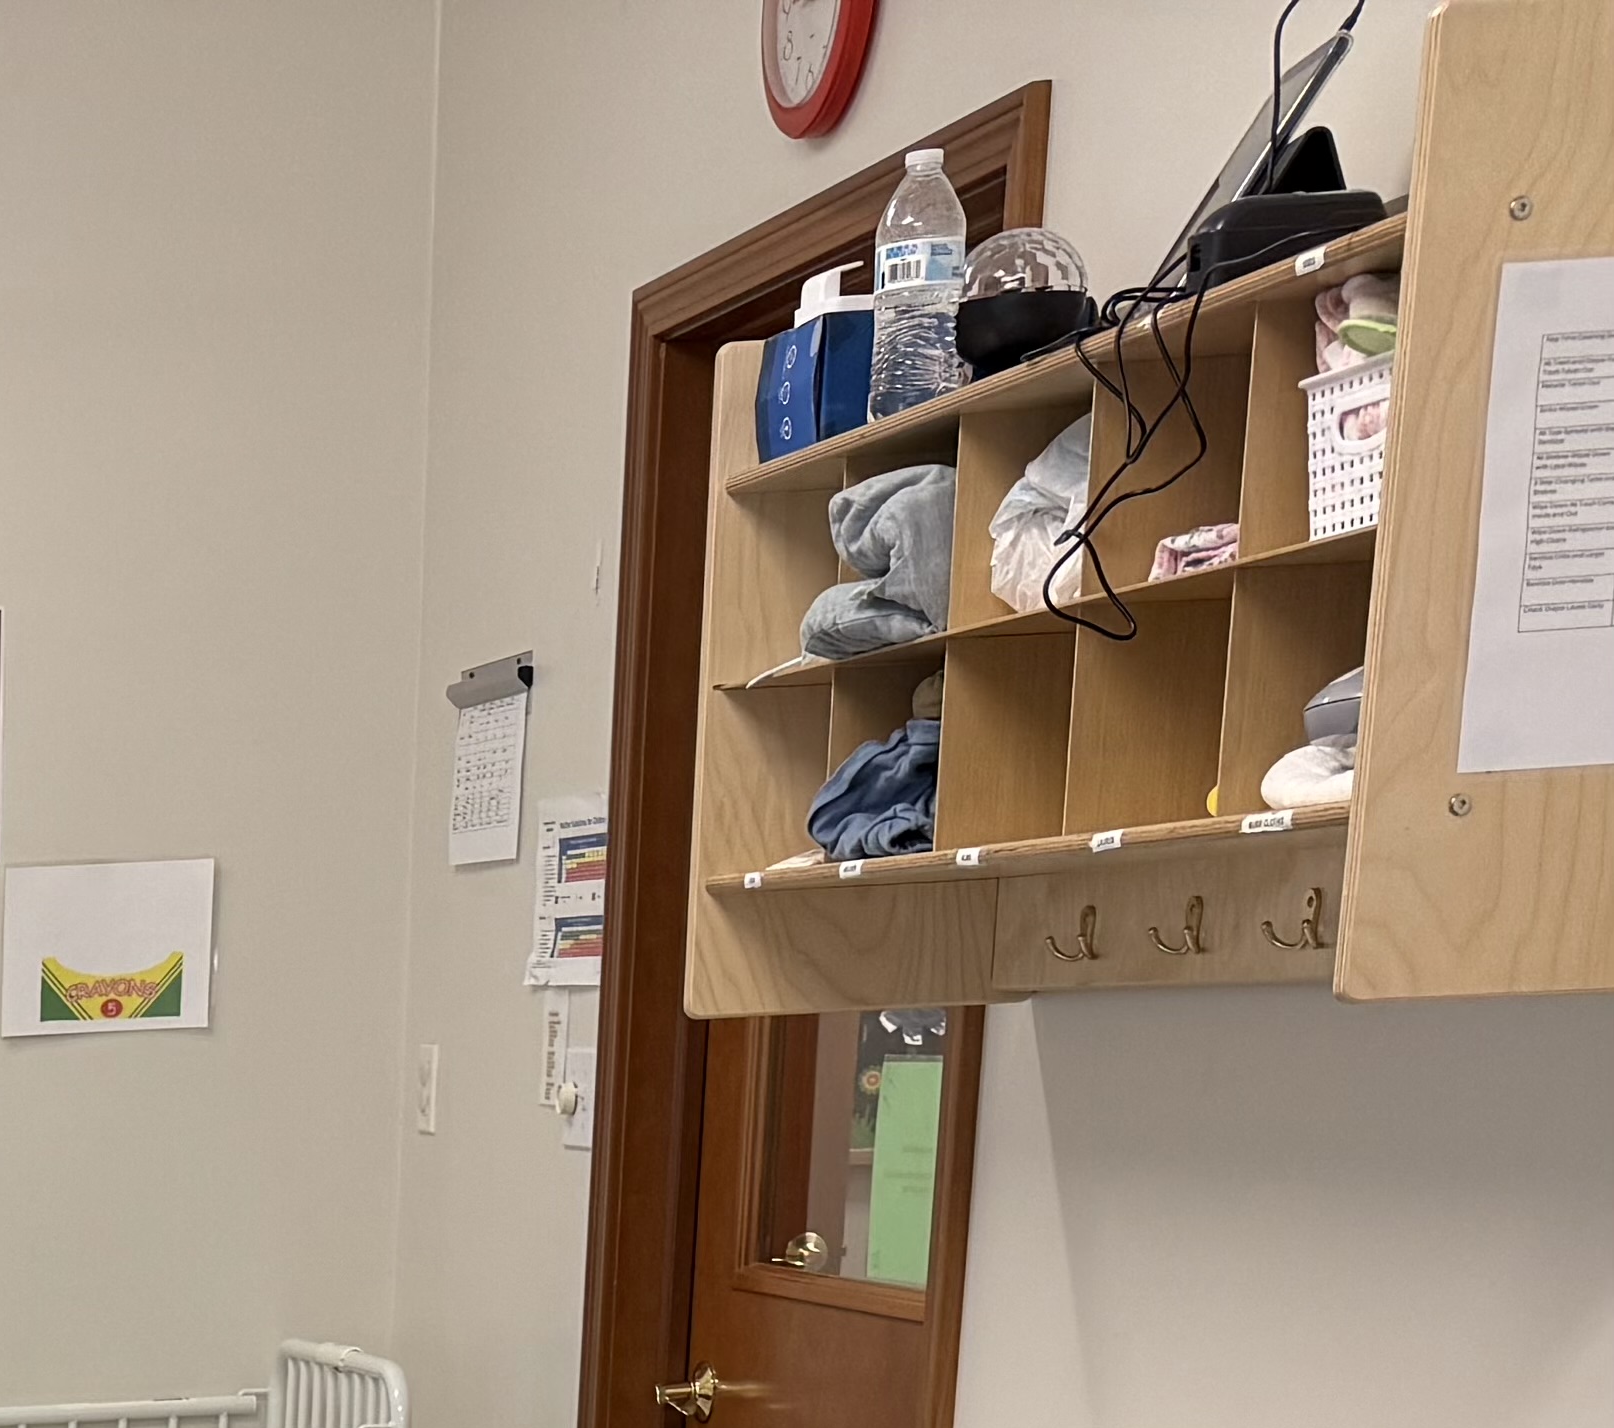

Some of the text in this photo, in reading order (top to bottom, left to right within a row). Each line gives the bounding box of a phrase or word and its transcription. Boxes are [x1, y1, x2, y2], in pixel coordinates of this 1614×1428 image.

[783, 30, 794, 61] 8
[795, 56, 803, 87] 7
[66, 978, 158, 1001] CRAYONS
[107, 1002, 118, 1016] 5
